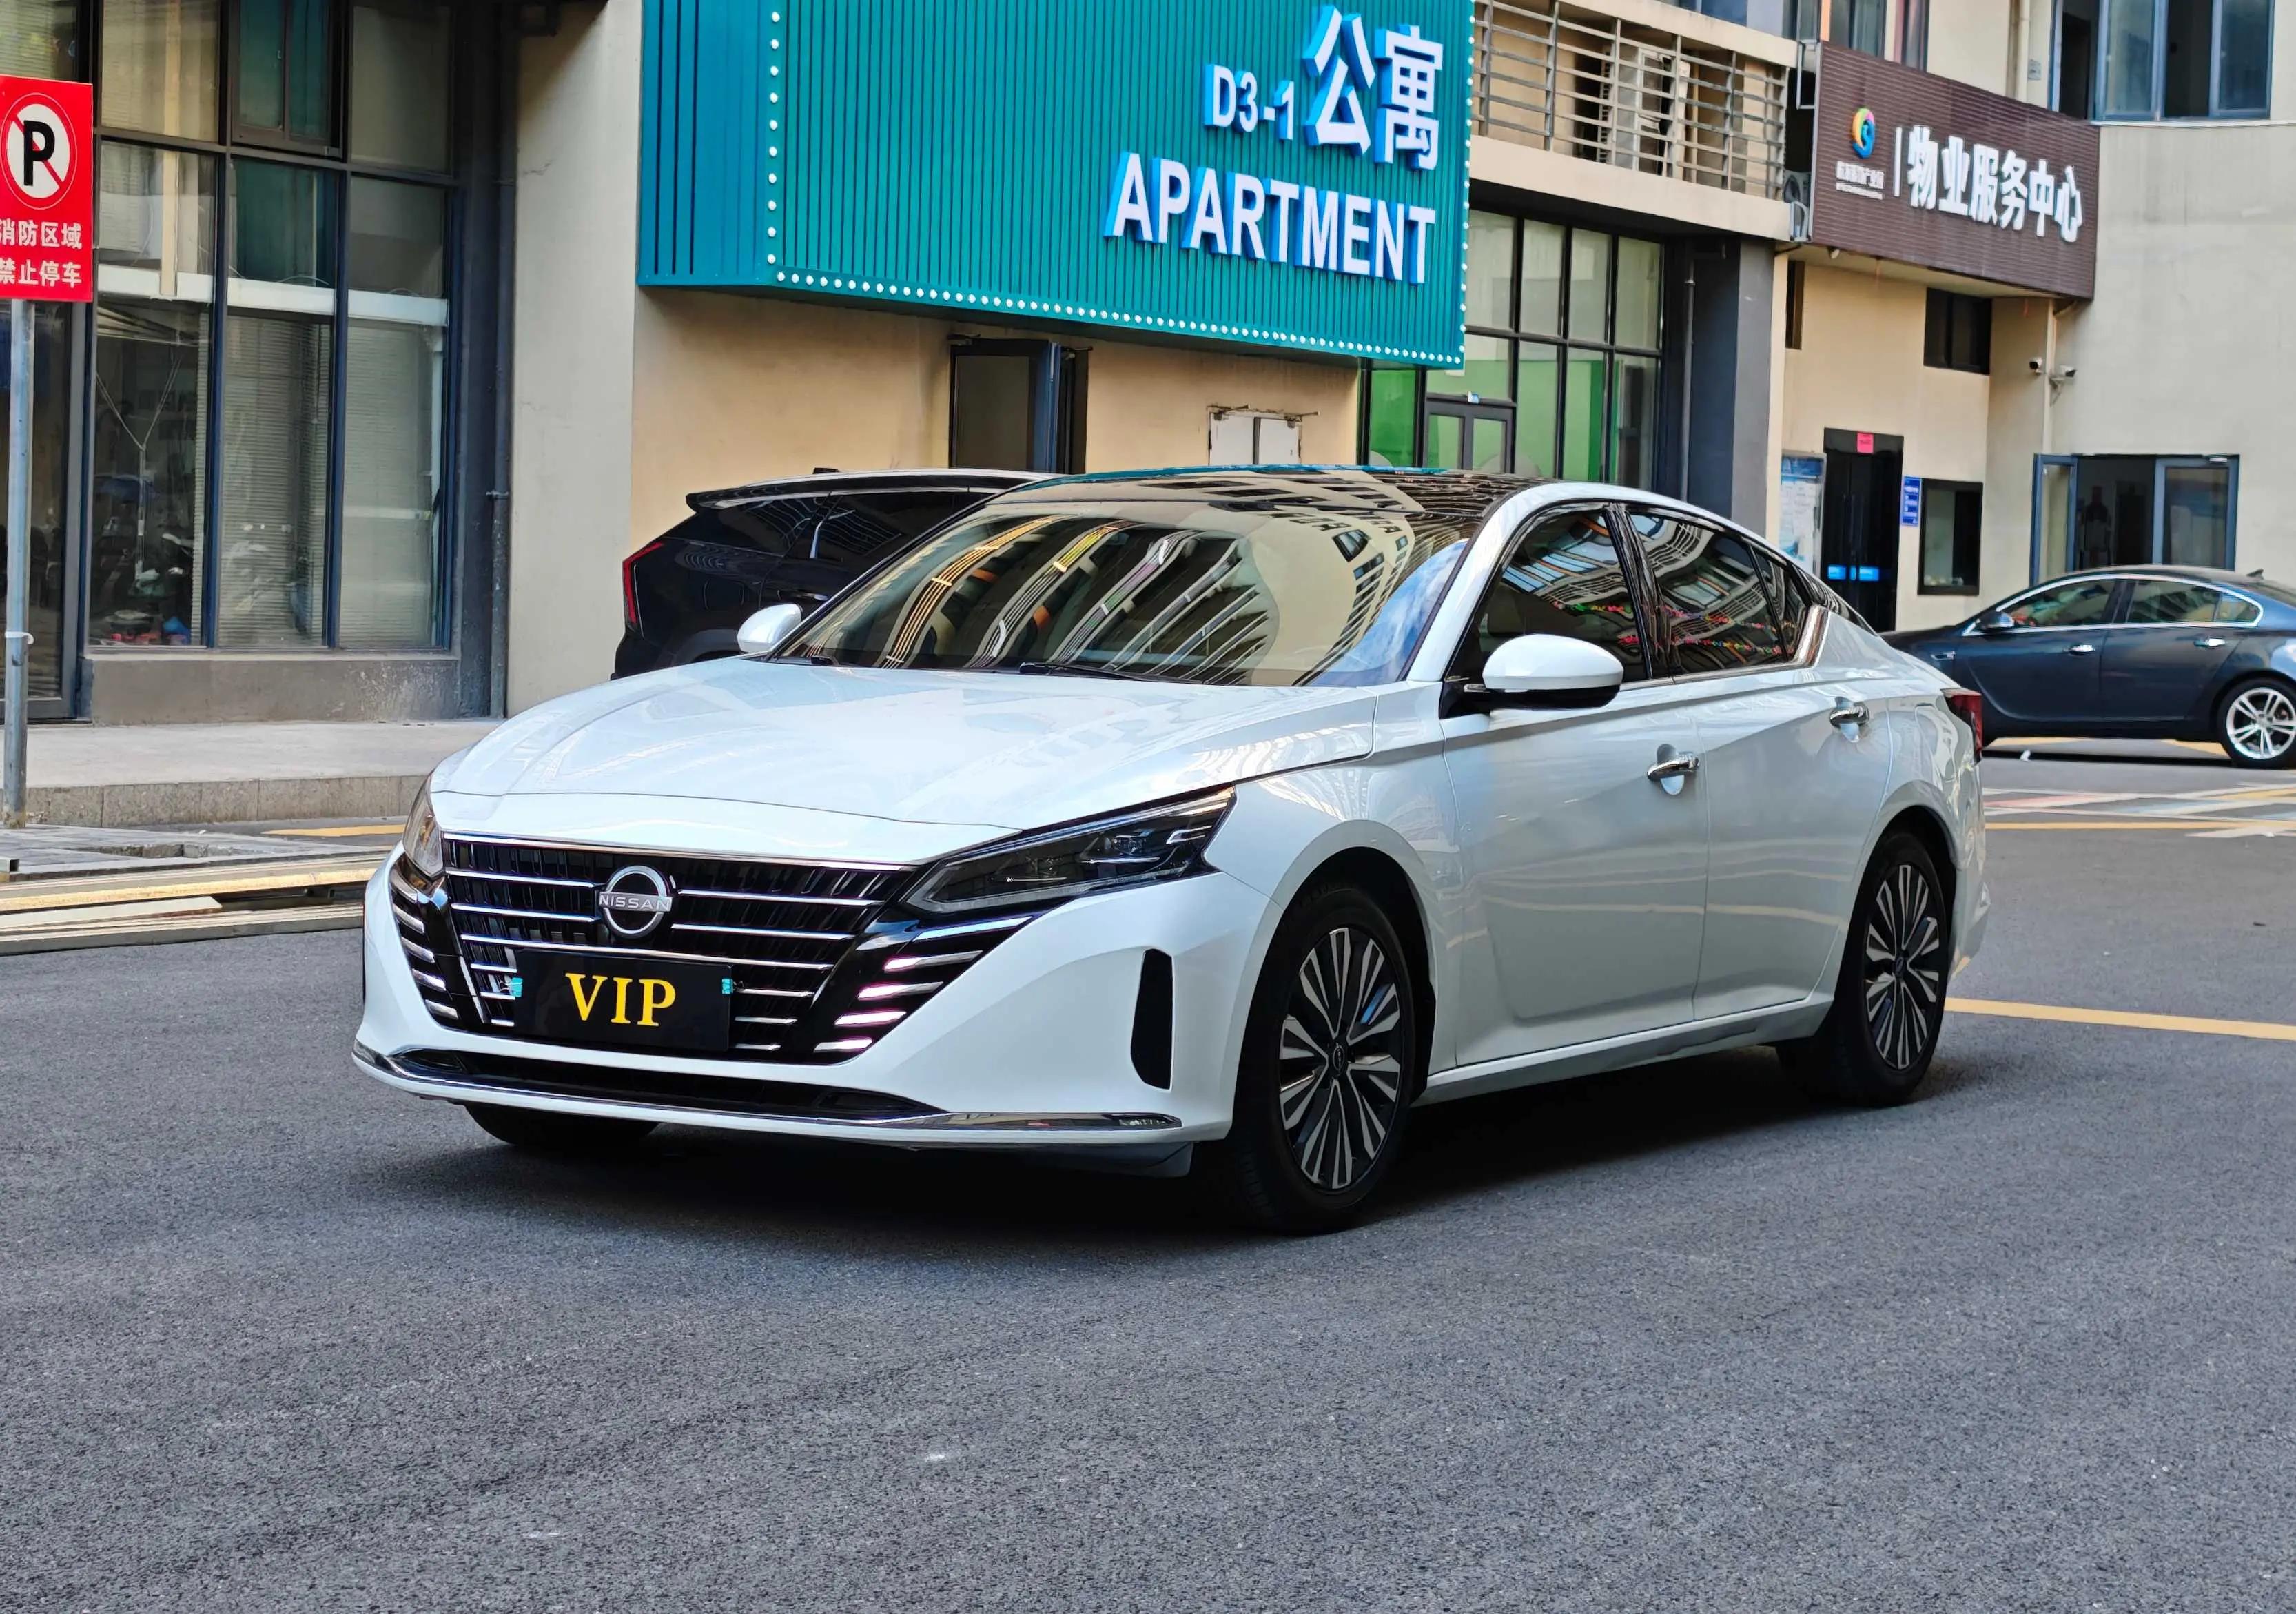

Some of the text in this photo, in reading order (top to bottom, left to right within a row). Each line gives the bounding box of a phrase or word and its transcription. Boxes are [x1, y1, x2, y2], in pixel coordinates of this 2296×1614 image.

[1204, 5, 1443, 170] D3-1 公寓
[1907, 125, 2082, 243] 物业服务中心
[0, 218, 83, 249] 消防区域
[1104, 151, 1436, 285] APARTMENT
[0, 258, 83, 288] 禁止停车
[599, 894, 670, 910] NISSAN
[565, 973, 676, 1026] VIP
